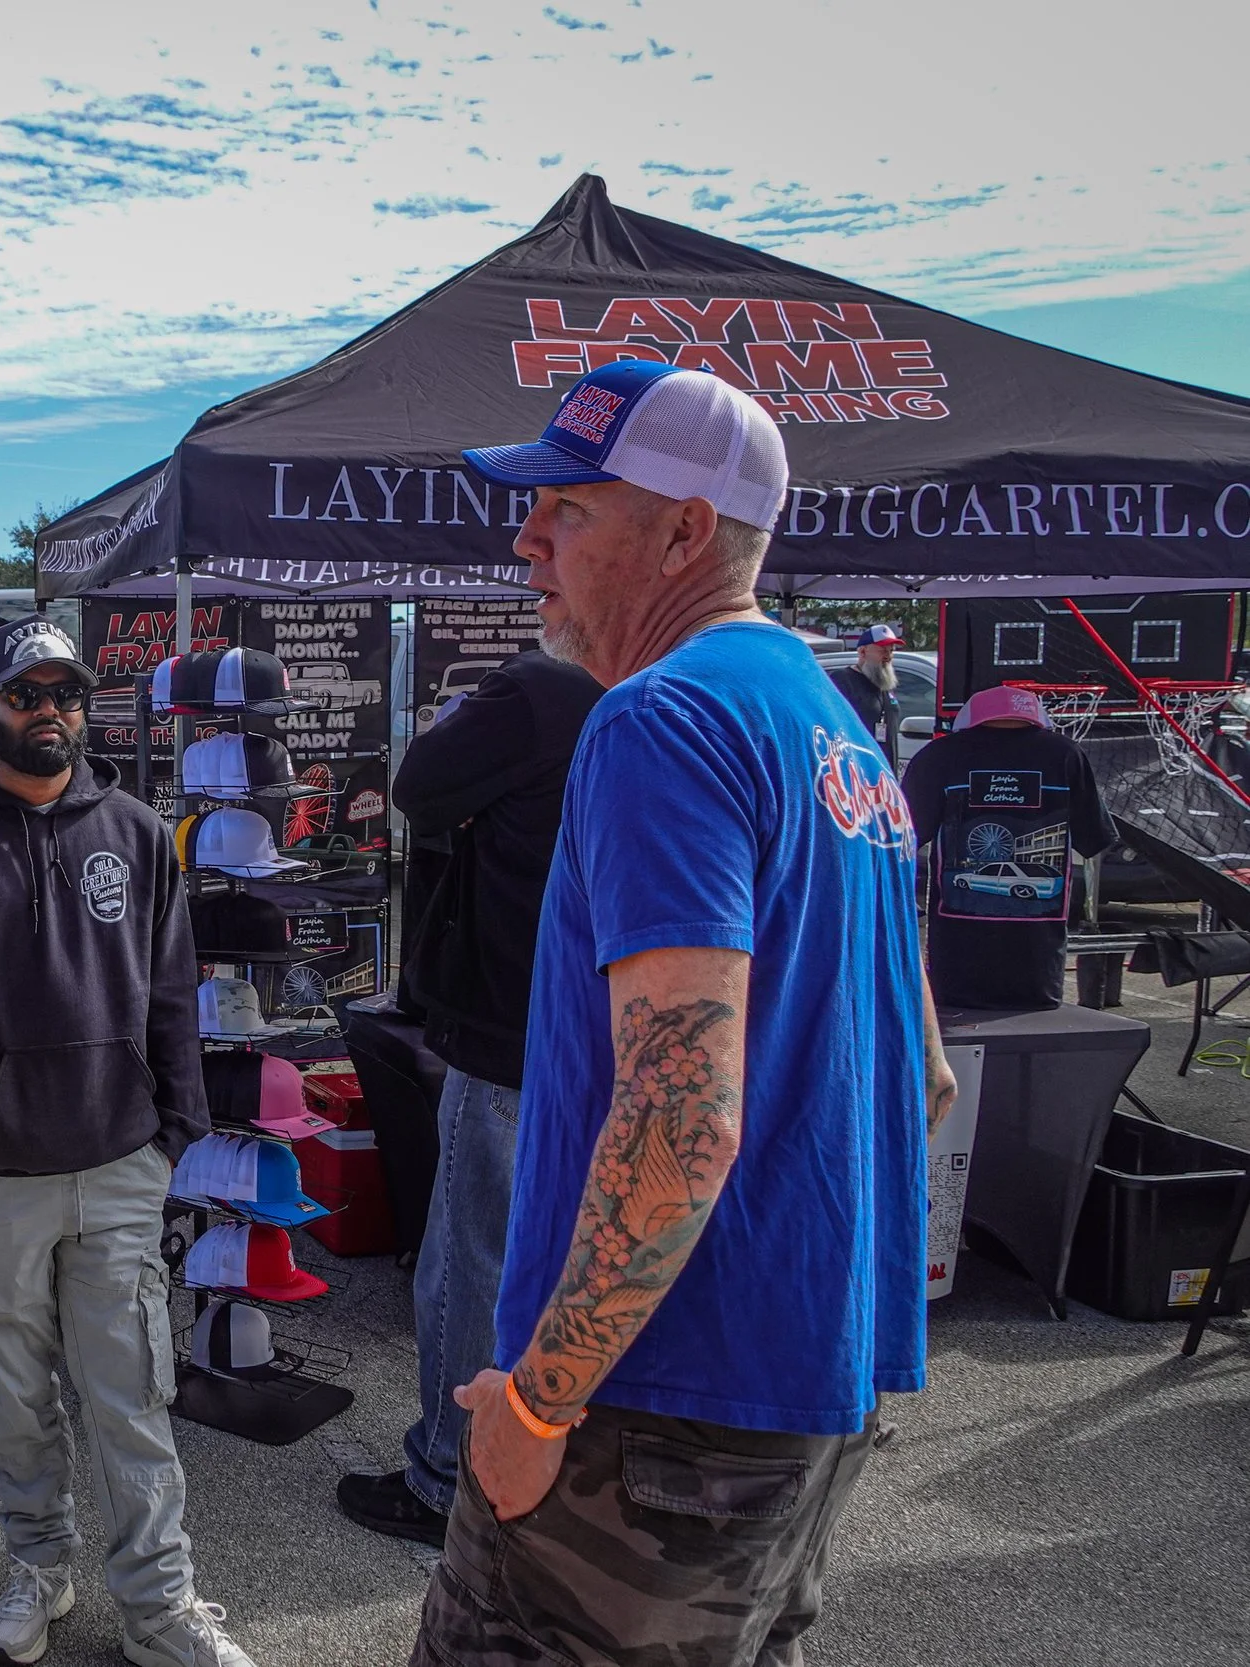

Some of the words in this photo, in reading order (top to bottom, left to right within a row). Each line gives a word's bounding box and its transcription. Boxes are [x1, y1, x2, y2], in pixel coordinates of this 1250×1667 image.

[525, 298, 884, 344] LAYIN
[573, 383, 626, 414] LAYIN
[751, 390, 950, 423] HING
[558, 401, 616, 432] FRAME
[553, 416, 605, 445] CLOTHING
[260, 603, 318, 620] BUILT
[323, 602, 372, 619] WITH
[425, 599, 474, 611] TEACH
[477, 602, 519, 612] YOUR
[521, 600, 539, 611] KI
[107, 606, 223, 645] LAYN
[422, 614, 442, 625] TO
[445, 614, 506, 625] CHANGE
[274, 622, 358, 639] DADDY'S
[431, 628, 461, 640] OIL,
[463, 628, 495, 639] NOT
[274, 642, 360, 659] MONEY...
[458, 643, 520, 653] GENDER
[96, 637, 229, 677] FRA
[274, 713, 321, 729] CALL
[326, 712, 356, 729] ME
[105, 727, 218, 746] CLTHG
[286, 732, 351, 749] DADDY
[991, 774, 1018, 784] Layin
[990, 784, 1019, 792] Frame
[352, 799, 380, 811] WHEEL
[983, 793, 1025, 804] Clothing
[93, 858, 113, 873] SOLO
[84, 867, 127, 891] CREATIONS
[93, 885, 122, 901] Customs
[298, 917, 325, 926] Layin
[297, 927, 326, 936] Frame
[292, 936, 332, 945] Clothing
